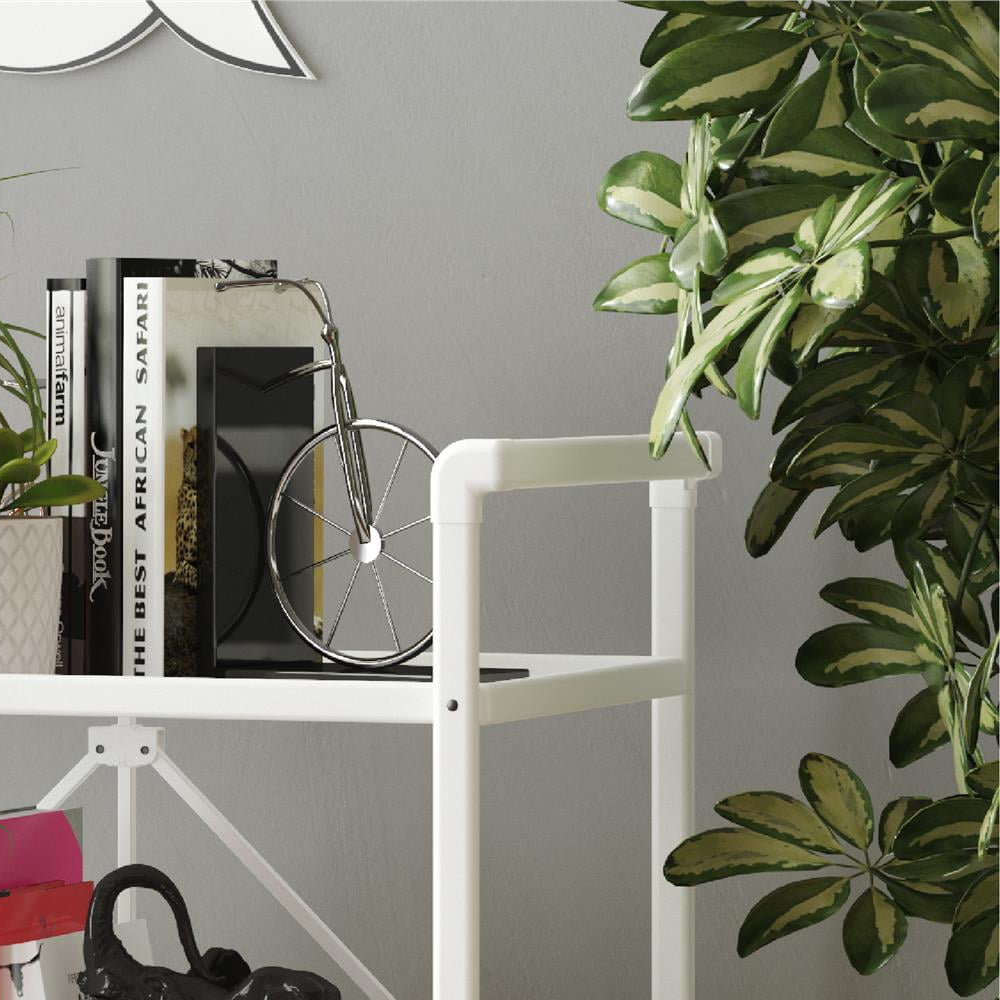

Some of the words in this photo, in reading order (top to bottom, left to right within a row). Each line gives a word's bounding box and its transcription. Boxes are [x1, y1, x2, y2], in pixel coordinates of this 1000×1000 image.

[136, 282, 149, 385] SAFARI
[135, 405, 148, 532] AFRICAN
[134, 549, 147, 619] BEST
[134, 628, 146, 676] THE
